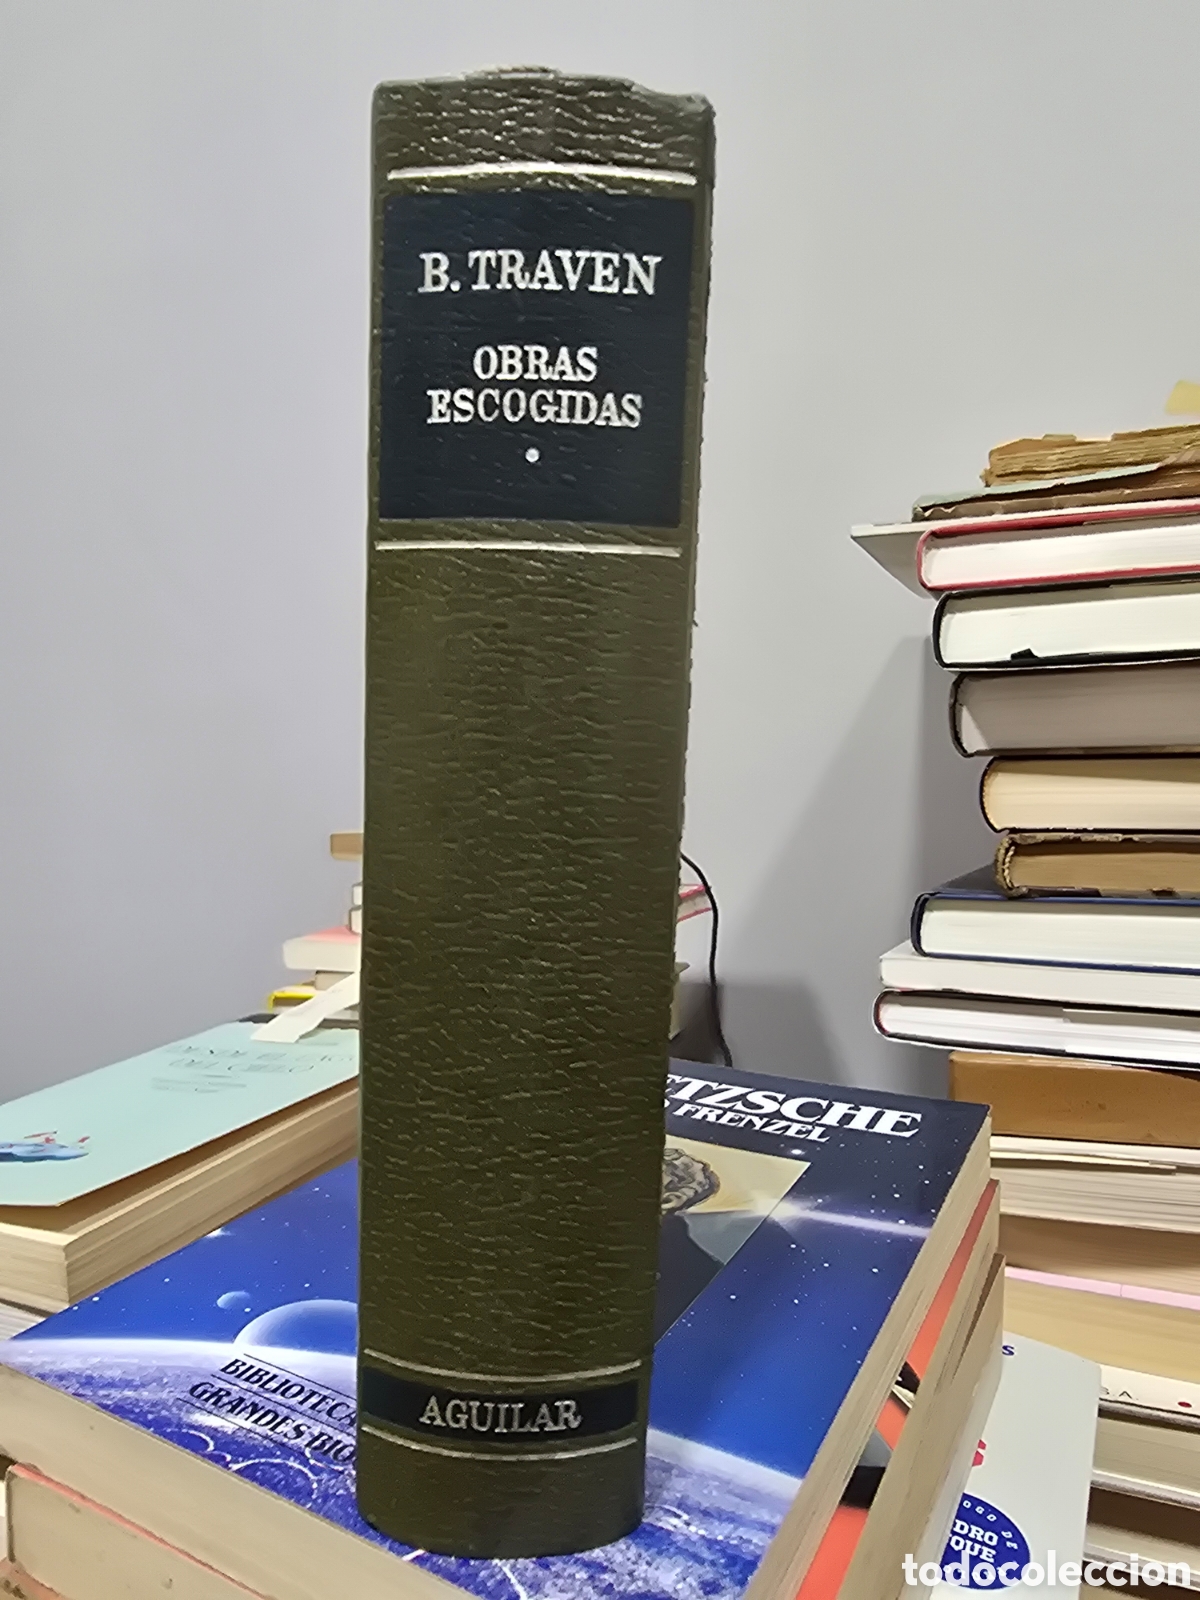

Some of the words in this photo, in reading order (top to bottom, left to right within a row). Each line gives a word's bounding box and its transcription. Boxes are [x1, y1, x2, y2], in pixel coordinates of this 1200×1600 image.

[418, 252, 461, 293] B.
[468, 249, 662, 295] TRAVEN
[473, 345, 598, 382] OBRAS
[426, 388, 643, 428] ESCOGIDAS
[672, 1103, 830, 1143] FRENZEL
[189, 1381, 312, 1440] GRANDES
[419, 1395, 582, 1433] AGUILAR
